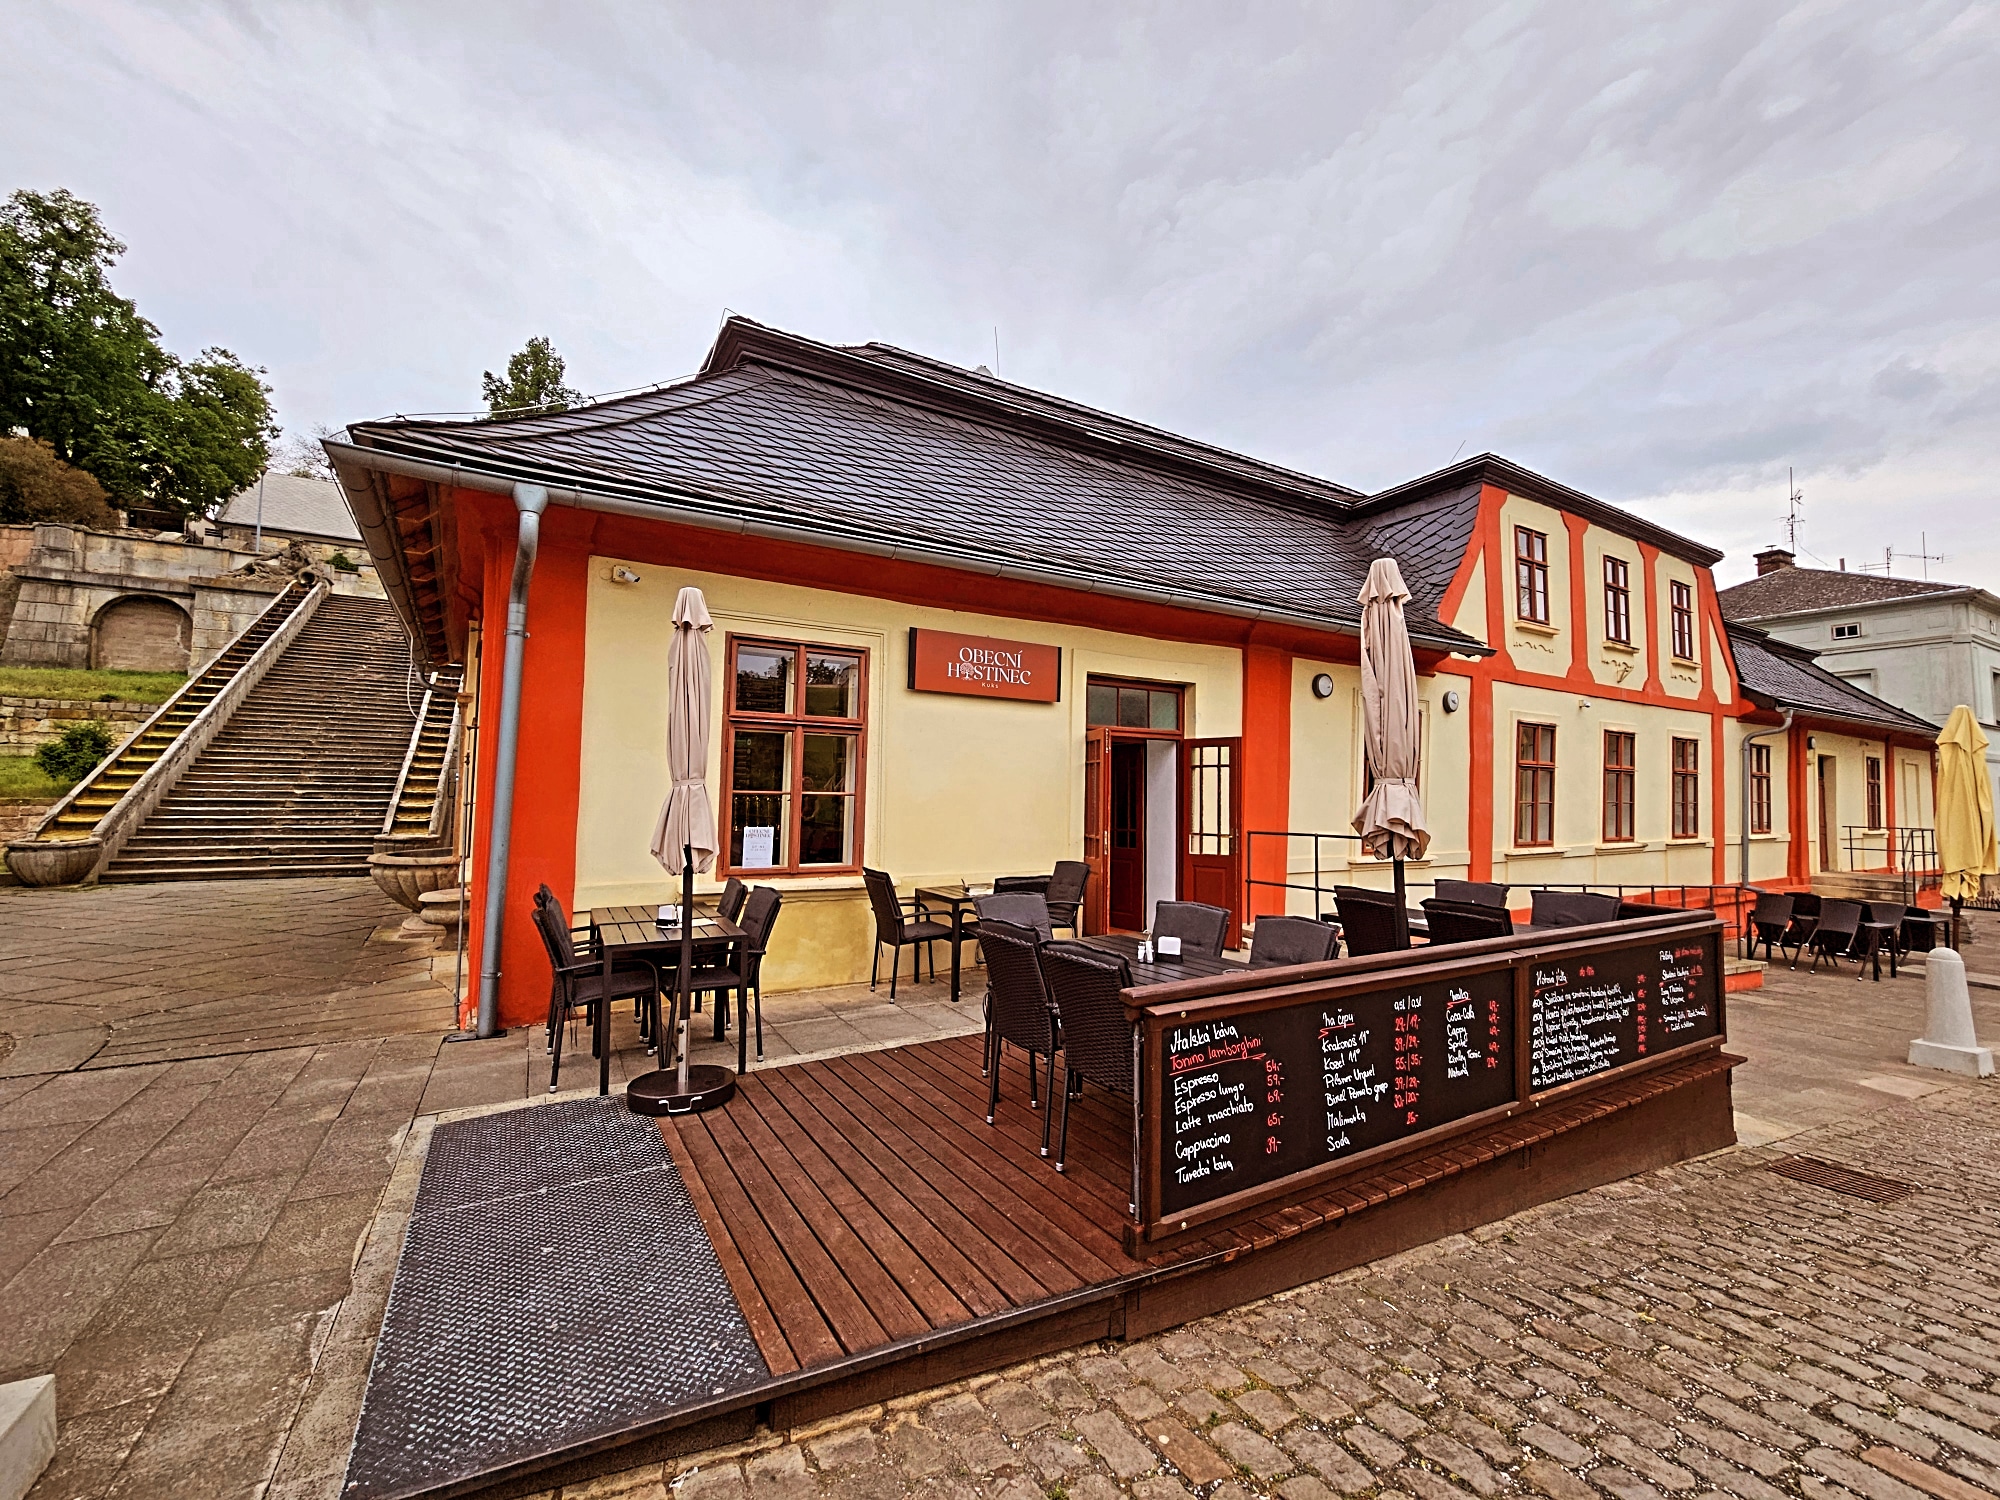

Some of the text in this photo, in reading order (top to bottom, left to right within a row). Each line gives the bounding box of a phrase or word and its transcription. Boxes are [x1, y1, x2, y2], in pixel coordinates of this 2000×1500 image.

[959, 647, 1023, 669] OBECNÍ
[947, 662, 1032, 685] HOSTINEC
[1446, 1004, 1475, 1022] Coca-Cola
[1447, 1024, 1468, 1042] Cappy
[1322, 1034, 1358, 1053] Krakonoš
[1447, 1038, 1468, 1052] Sprite
[1170, 1052, 1205, 1071] Tonino
[1323, 1053, 1345, 1071] Kozel
[1174, 1073, 1219, 1097] Espresso
[1322, 1073, 1353, 1088] Pilsner
[1174, 1088, 1217, 1115] Espresso
[1218, 1083, 1245, 1101] lungo
[1175, 1116, 1202, 1134] Latte
[1207, 1096, 1254, 1124] macchiato
[1175, 1133, 1231, 1161] Cappuccino
[1327, 1131, 1350, 1152] Soda
